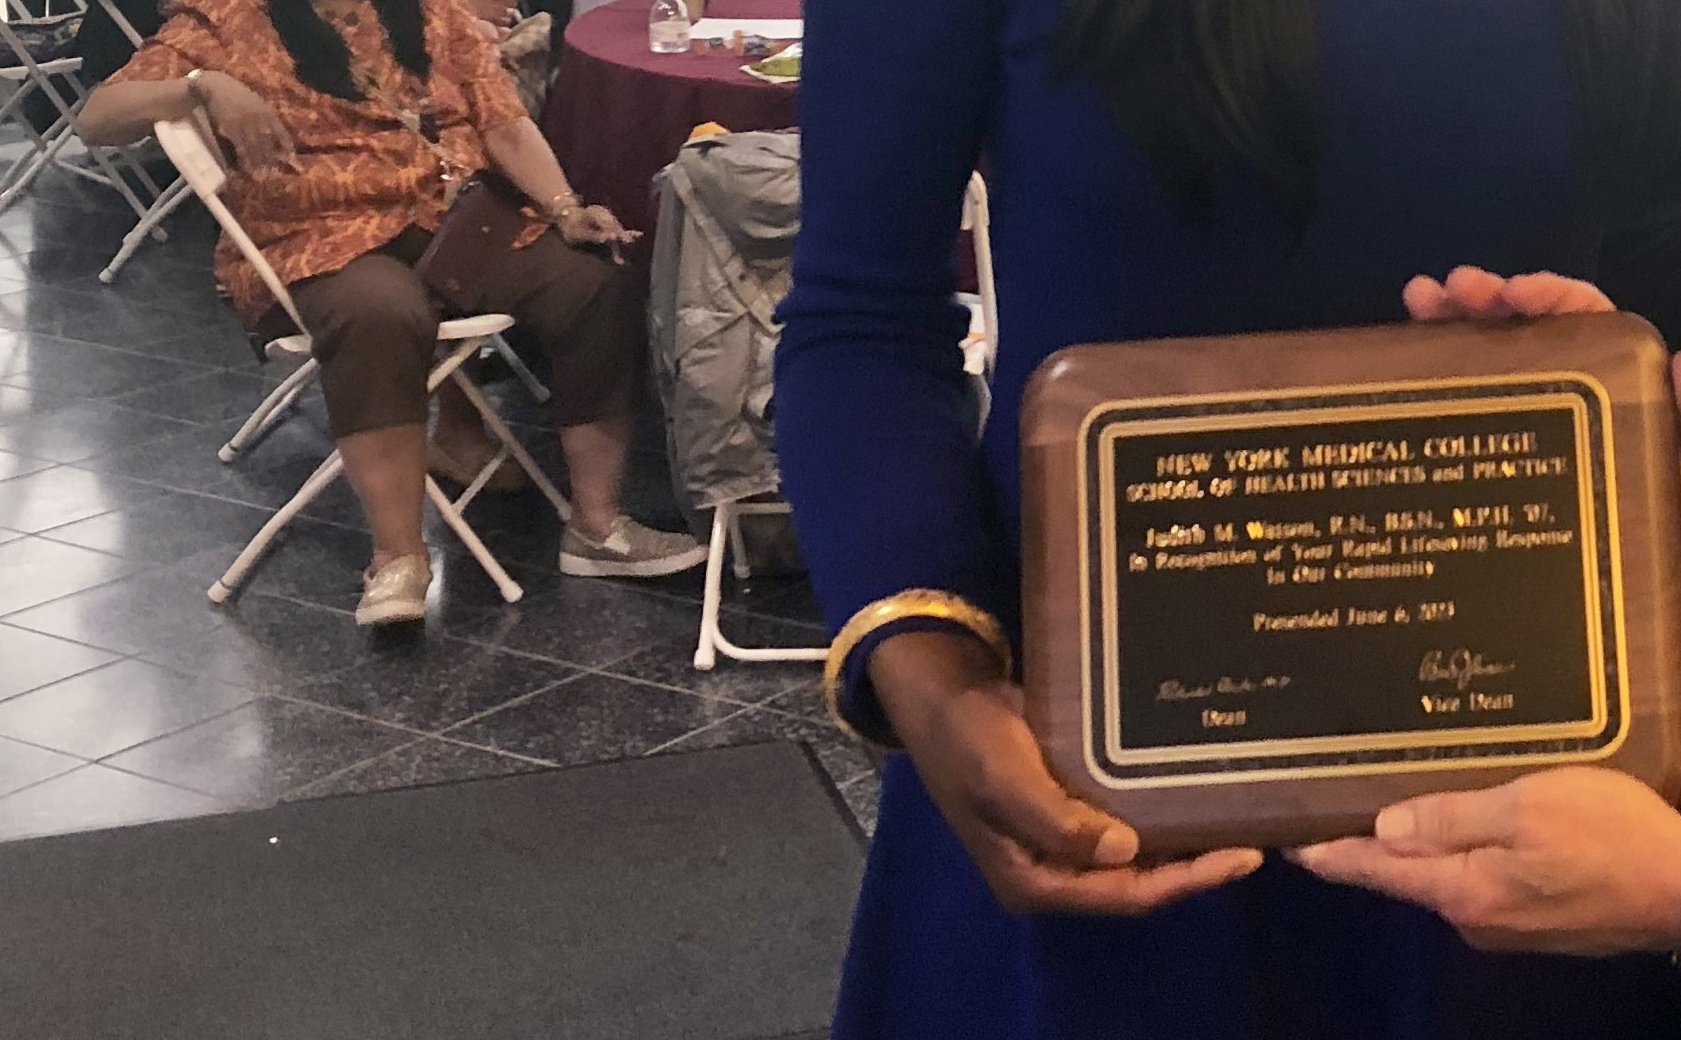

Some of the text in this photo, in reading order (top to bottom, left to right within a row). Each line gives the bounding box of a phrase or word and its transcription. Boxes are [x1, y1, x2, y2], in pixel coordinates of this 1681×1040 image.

[1157, 431, 1537, 477] NEW YORK MEDICAL COLLEGE
[1126, 456, 1567, 503] SCHOOL OF HEALTH SCIENCES and PRACTICE
[1155, 548, 1257, 571] Recognition
[1263, 544, 1285, 562] of
[1291, 542, 1333, 561] Your
[1342, 535, 1393, 558] Rapid
[1400, 533, 1488, 554] Lifesaving
[1496, 528, 1573, 549] Response
[1292, 563, 1326, 583] Our
[1333, 560, 1434, 580] Community
[1253, 607, 1339, 632] Presented
[1345, 606, 1388, 627] June
[1420, 692, 1515, 713] Vice Dean
[1201, 709, 1248, 728] Dean
